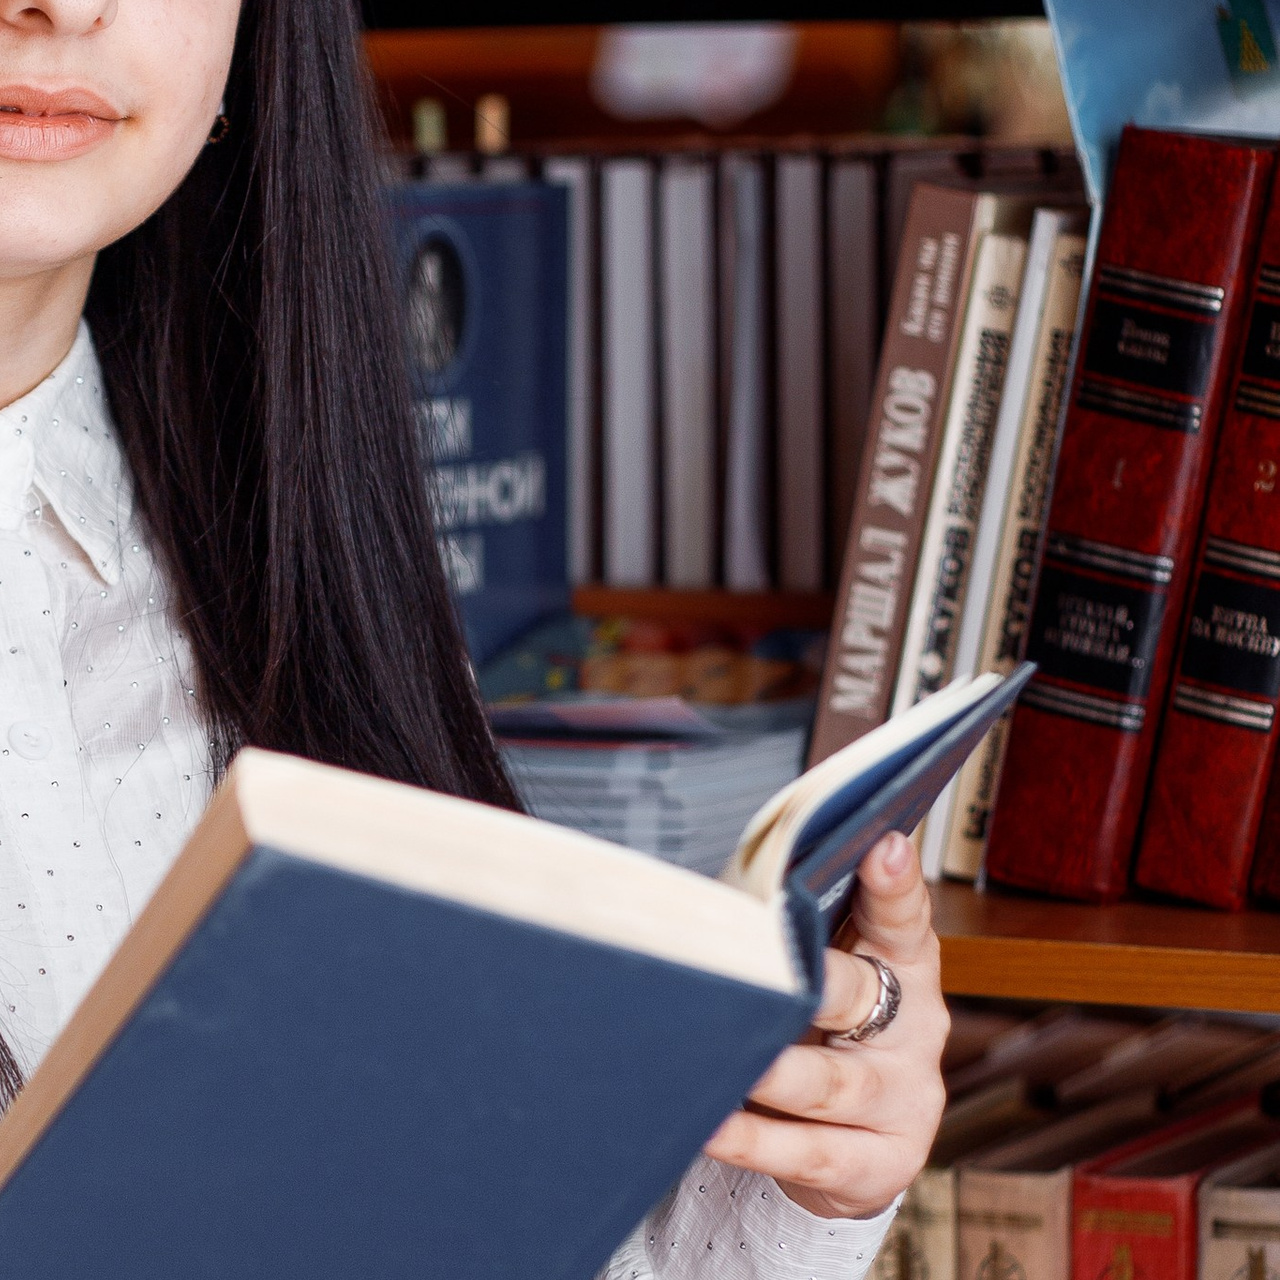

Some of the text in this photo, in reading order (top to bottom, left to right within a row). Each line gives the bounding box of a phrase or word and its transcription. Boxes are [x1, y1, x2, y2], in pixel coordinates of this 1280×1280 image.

[829, 363, 936, 720] МАРШАЛ ЖУКОВ
[1253, 458, 1278, 493] 2
[920, 523, 973, 660] ЖУКОВ
